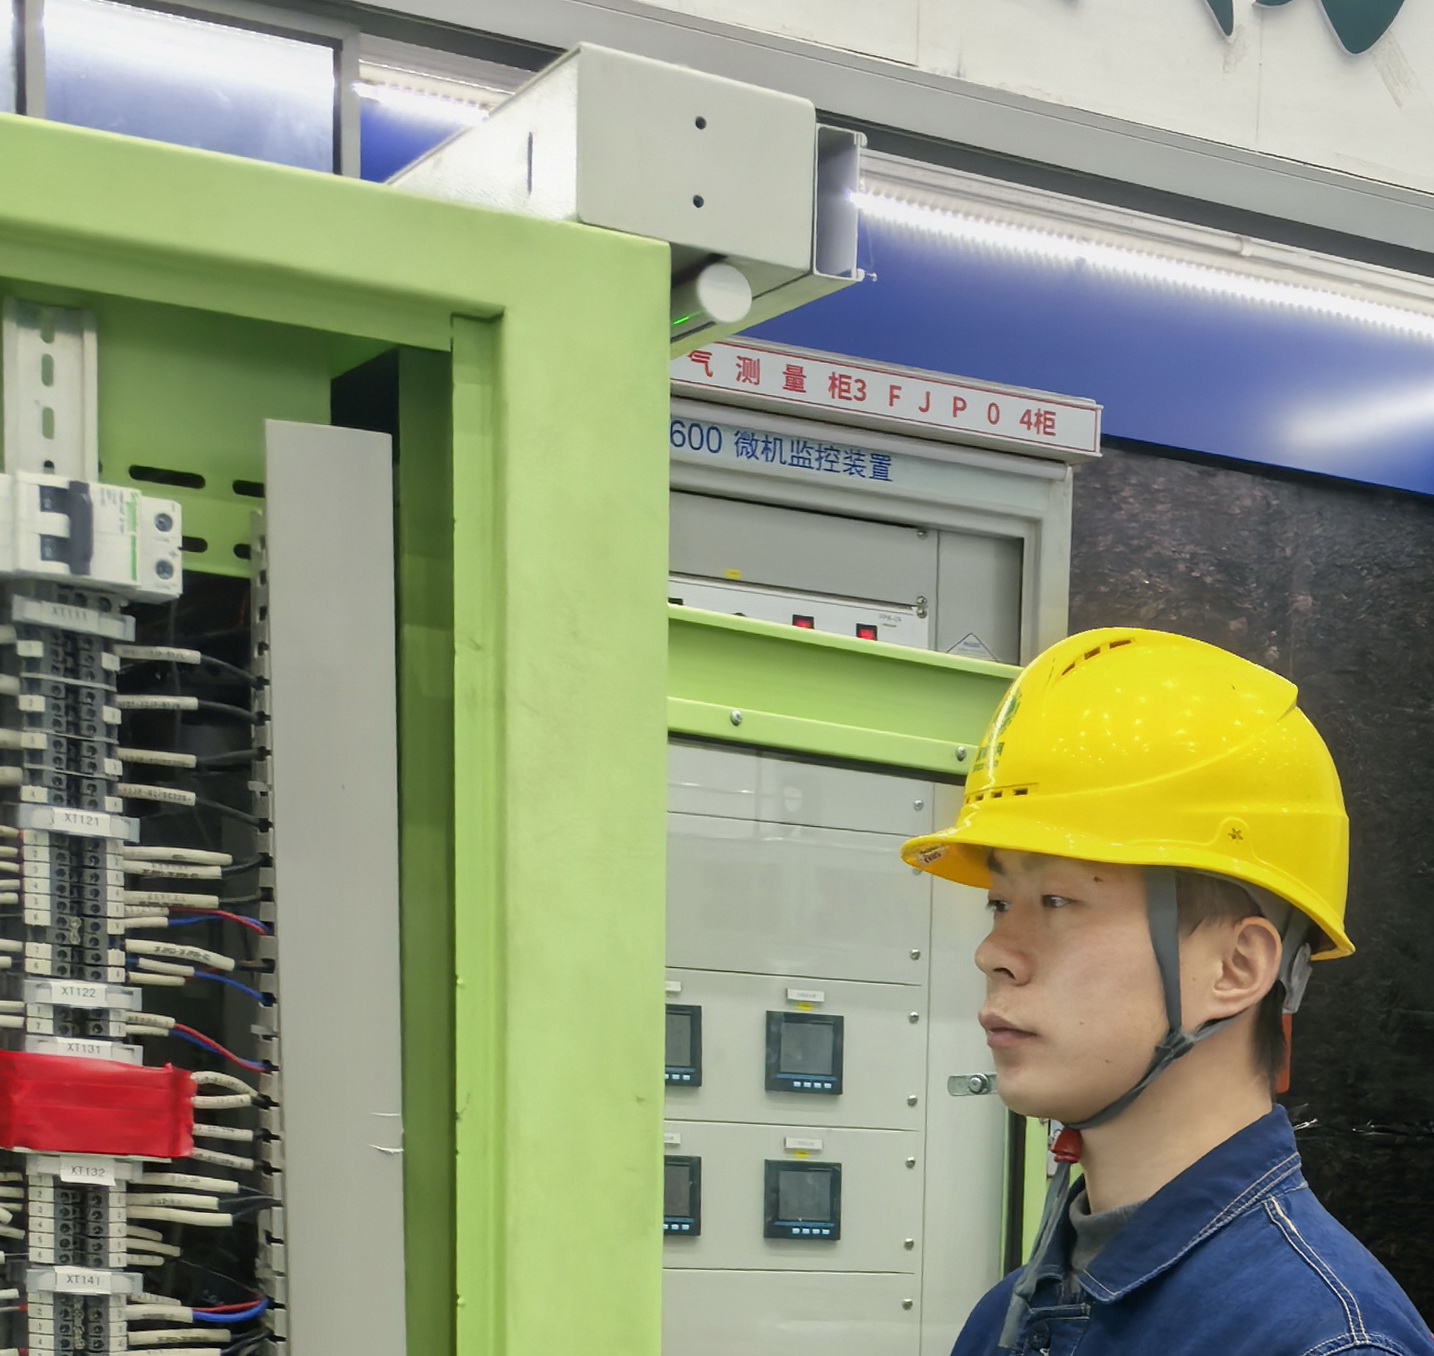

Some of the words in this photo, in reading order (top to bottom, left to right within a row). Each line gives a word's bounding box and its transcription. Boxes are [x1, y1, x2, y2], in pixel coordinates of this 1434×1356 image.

[733, 429, 894, 482] 微机监控装置
[63, 812, 100, 826] XT121
[61, 985, 97, 999] XT122
[67, 1042, 101, 1054] XT131
[71, 1165, 106, 1177] XT132
[66, 1274, 100, 1287] XT141
